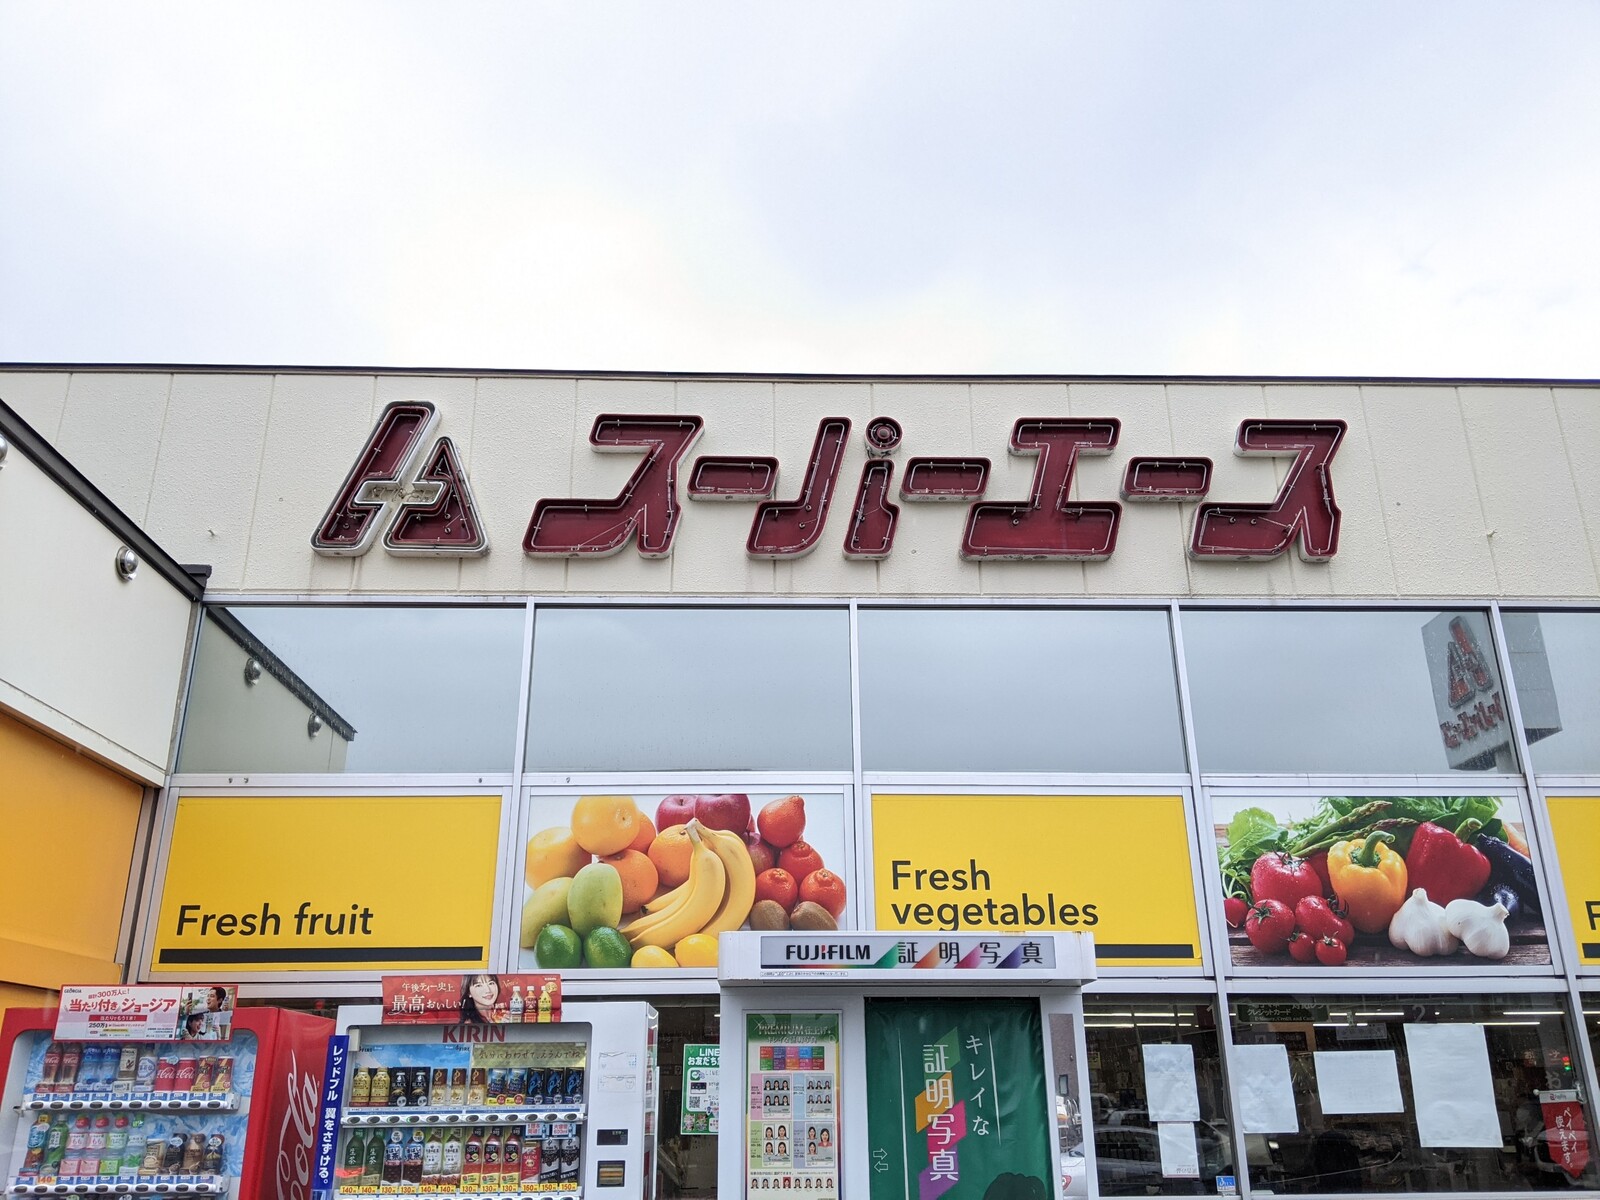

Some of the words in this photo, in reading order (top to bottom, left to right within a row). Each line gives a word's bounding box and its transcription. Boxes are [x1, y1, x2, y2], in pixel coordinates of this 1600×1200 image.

[891, 859, 991, 891] Fresh
[176, 903, 281, 936] Fresh
[294, 902, 374, 936] fruit
[890, 893, 1099, 931] vegetables
[786, 944, 871, 960] FUJIFILM
[897, 941, 1044, 964] 証明写真
[402, 982, 456, 993] 午後ティー史上
[121, 998, 177, 1013] ジョージア
[442, 1025, 507, 1043] KIRIN
[327, 1045, 343, 1101] レッドブル
[688, 1056, 720, 1066] お友だち
[965, 1035, 990, 1136] キレイな
[922, 1044, 959, 1181] 証明写真
[318, 1108, 337, 1184] 翼をさずける。
